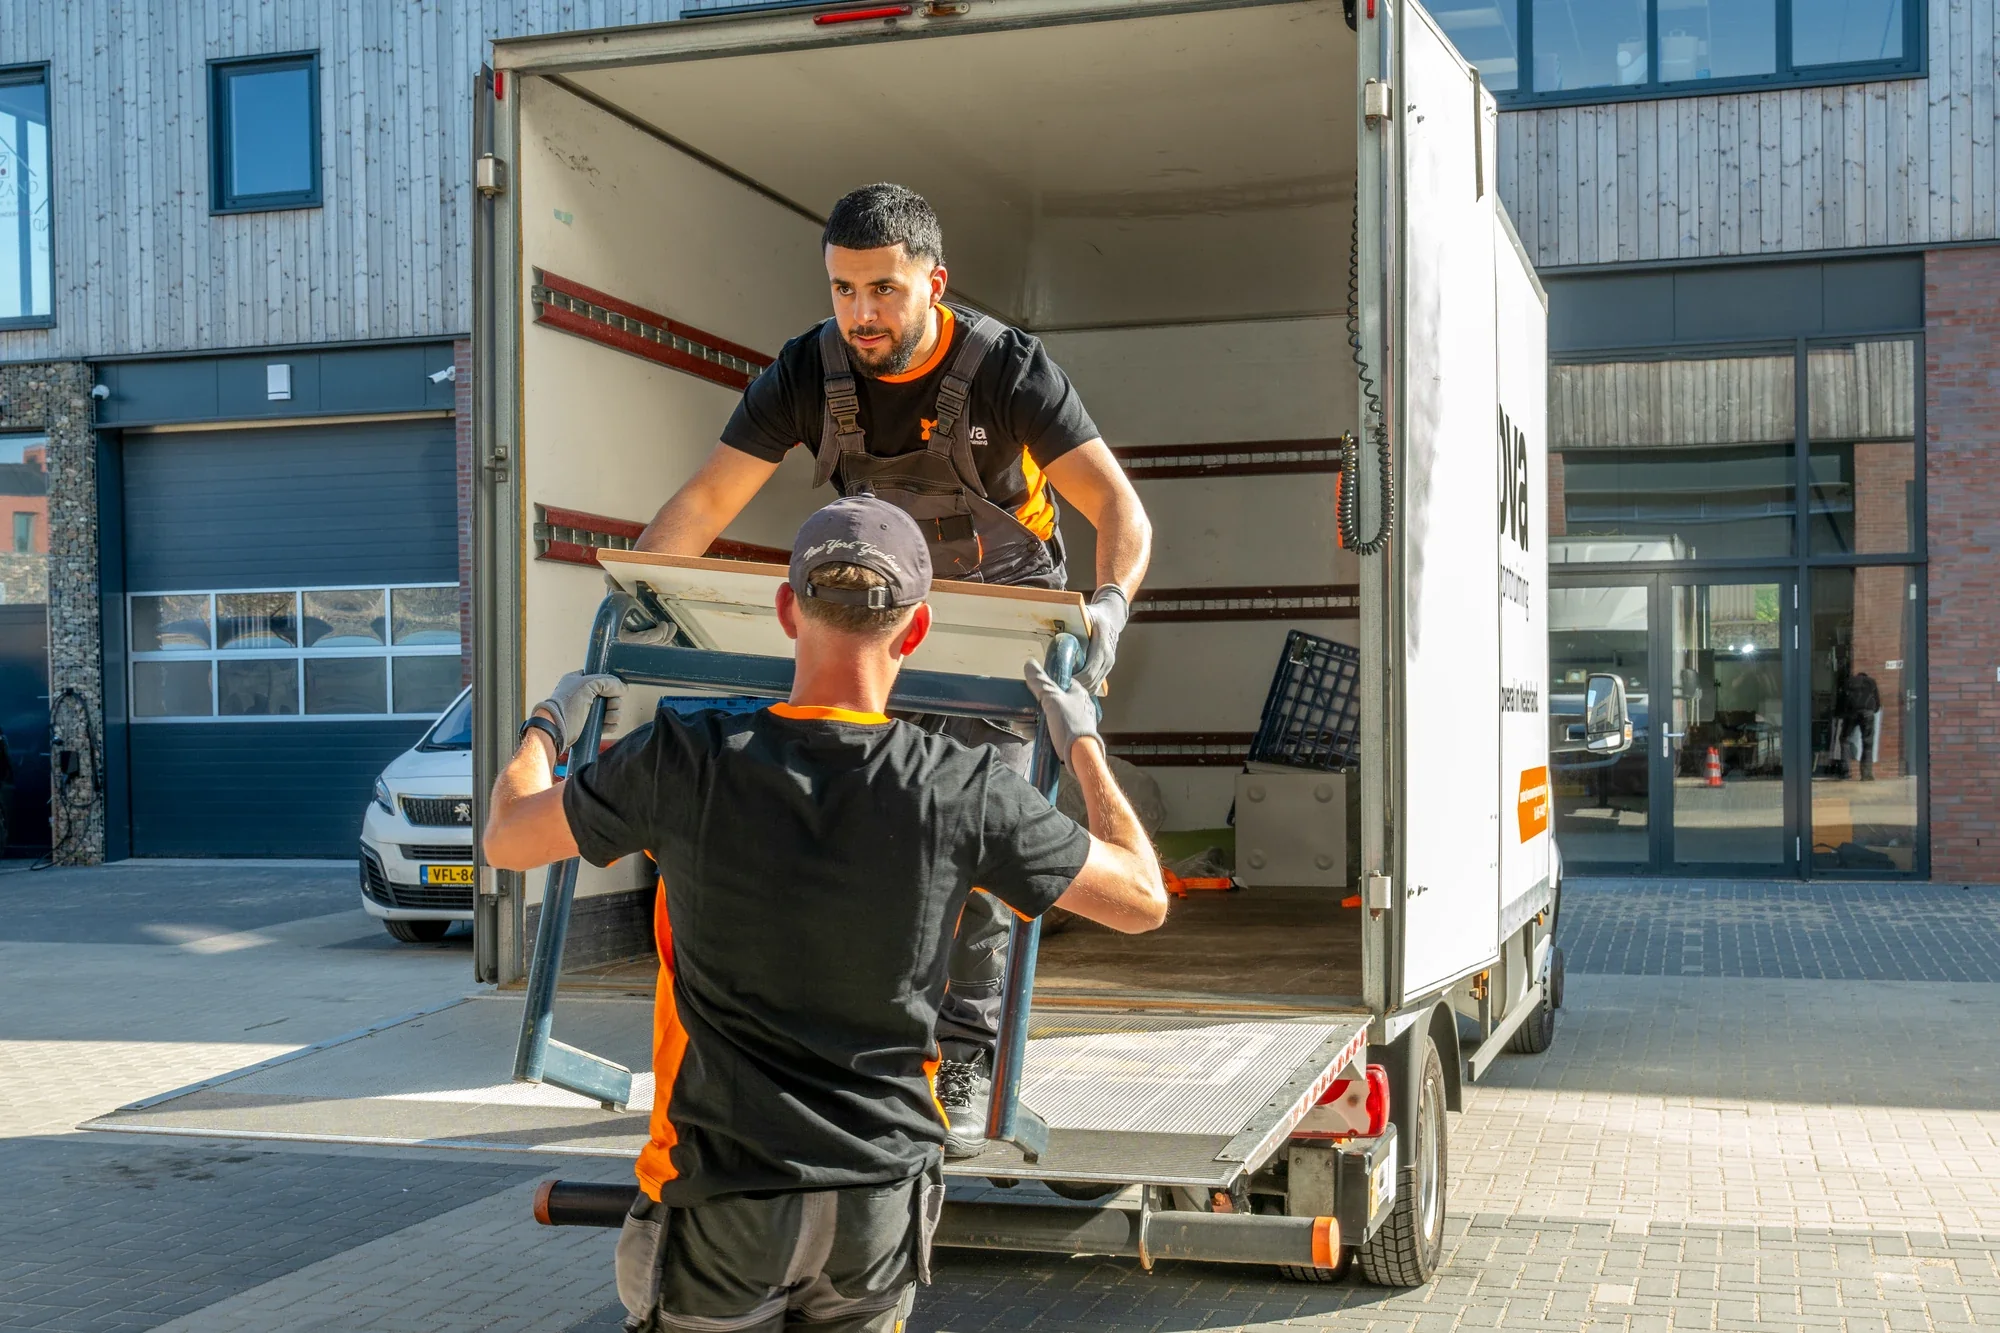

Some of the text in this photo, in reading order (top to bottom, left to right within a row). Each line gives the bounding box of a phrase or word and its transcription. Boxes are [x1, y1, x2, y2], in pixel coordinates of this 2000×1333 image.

[803, 539, 901, 572] New York Yankees
